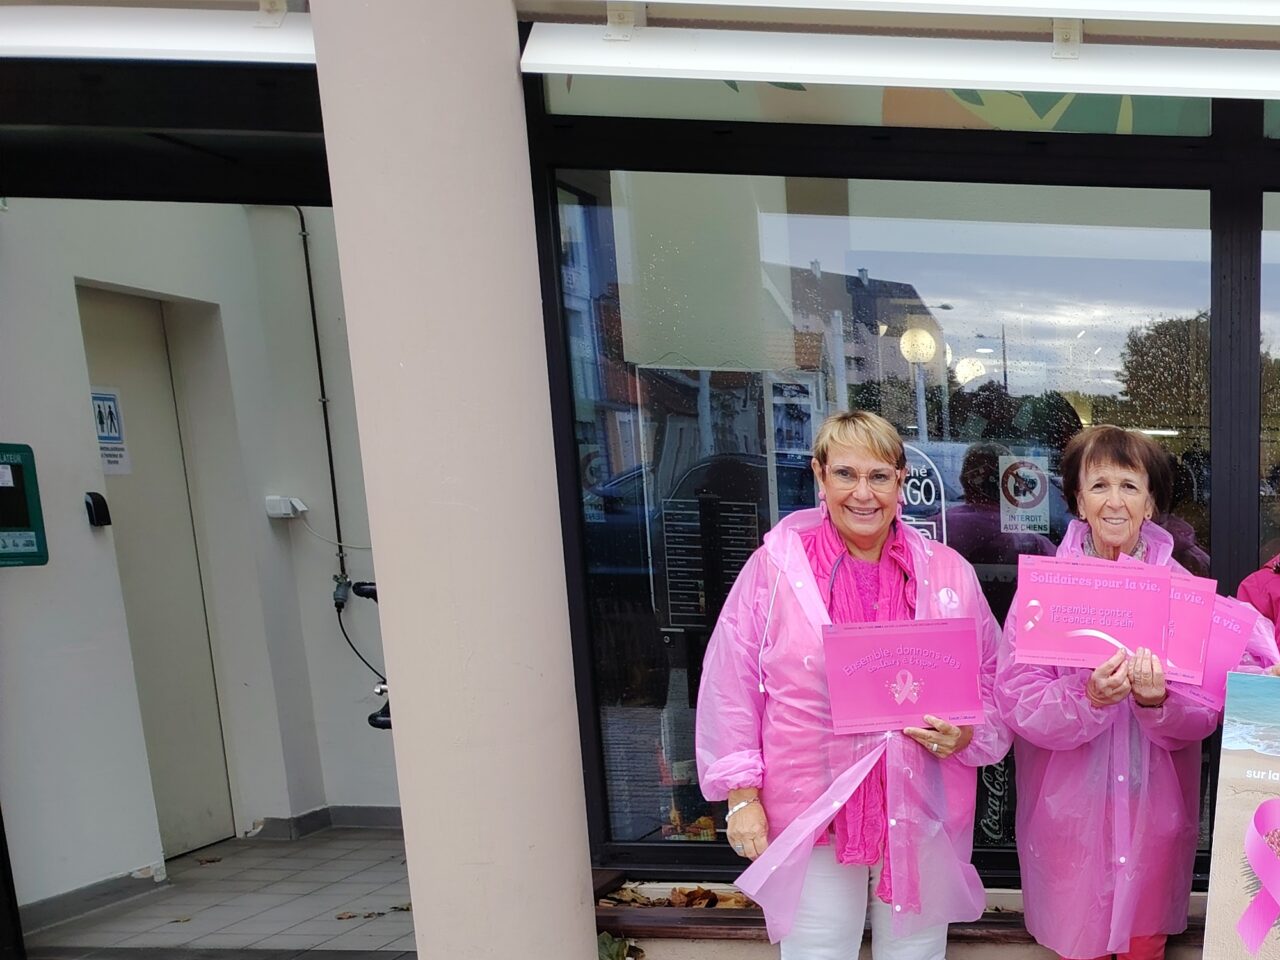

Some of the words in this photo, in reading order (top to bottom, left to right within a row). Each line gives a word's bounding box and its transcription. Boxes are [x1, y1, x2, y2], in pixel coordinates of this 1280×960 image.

[1021, 524, 1048, 532] CHIENS
[1030, 572, 1092, 587] Solidaires
[1094, 575, 1122, 590] pour
[1124, 577, 1137, 589] la
[1139, 579, 1161, 593] vie,
[1170, 588, 1181, 600] la
[1049, 603, 1097, 616] ensemble
[1099, 607, 1133, 619] contre
[1050, 613, 1062, 624] le
[1062, 615, 1097, 626] cancer
[1099, 614, 1112, 626] du
[1114, 616, 1134, 629] sein
[896, 644, 940, 660] donnons
[1246, 769, 1266, 779] sur
[1268, 770, 1279, 780] la
[980, 760, 1005, 840] Coca-Col
